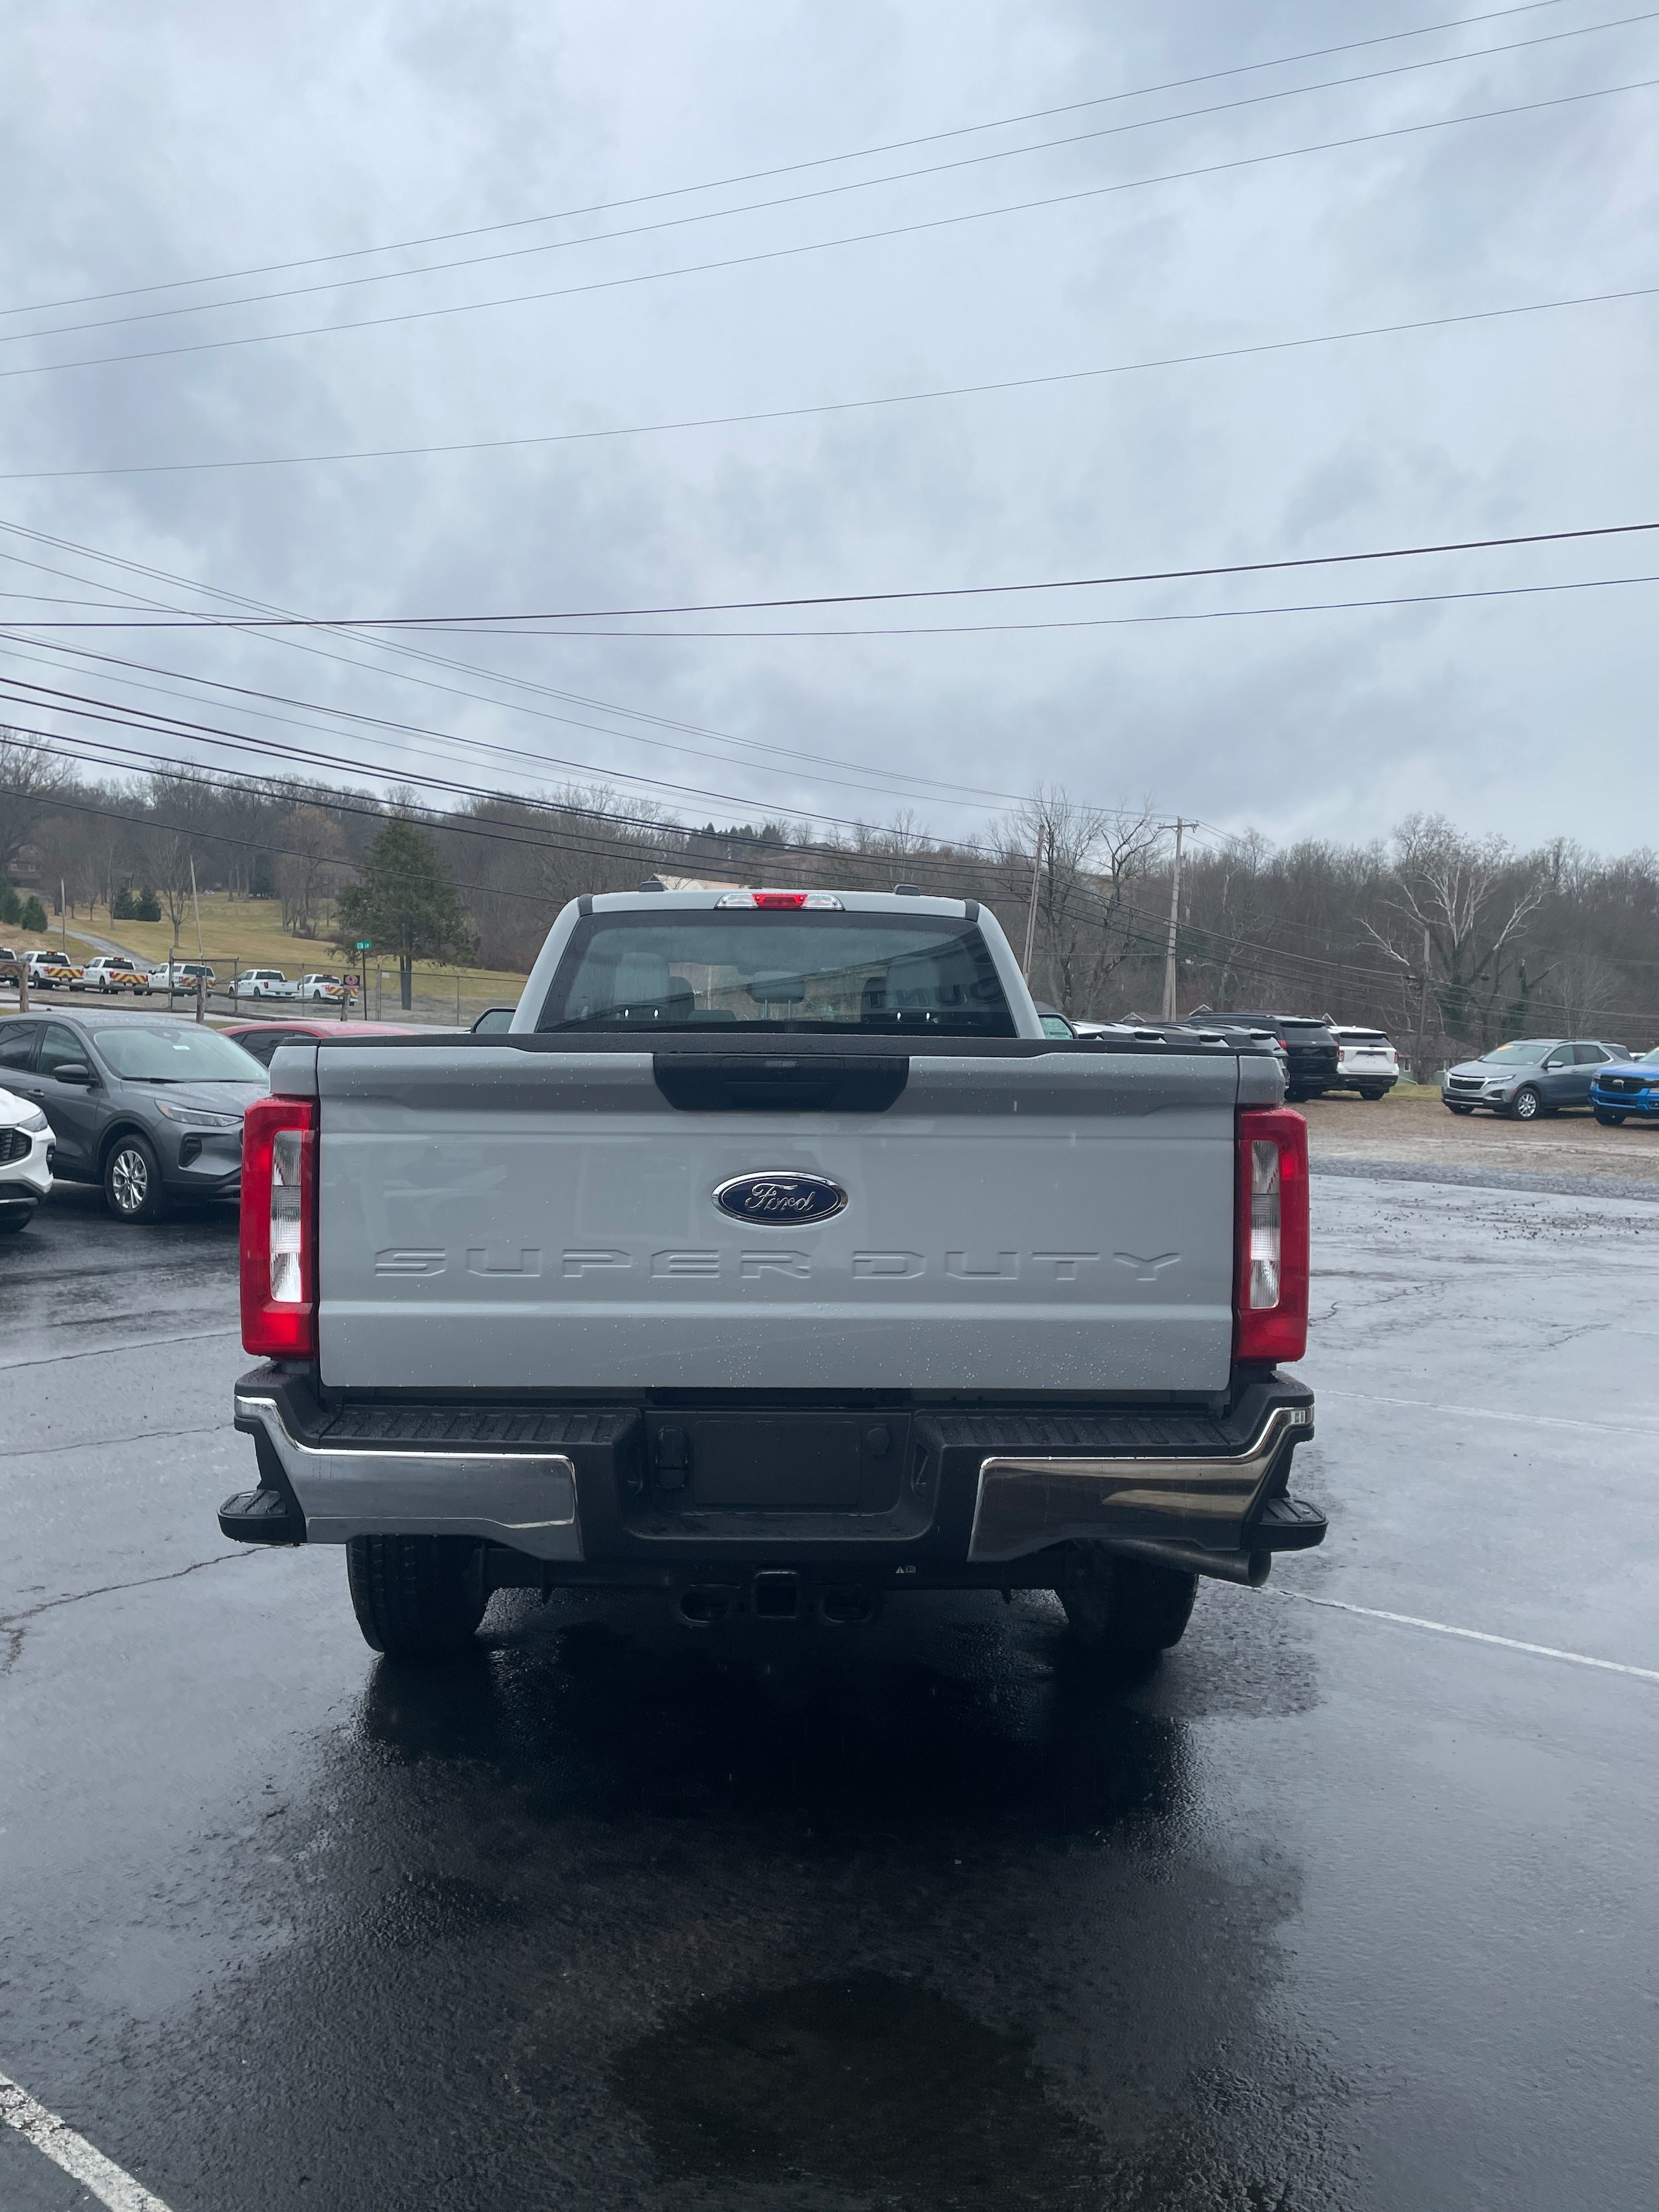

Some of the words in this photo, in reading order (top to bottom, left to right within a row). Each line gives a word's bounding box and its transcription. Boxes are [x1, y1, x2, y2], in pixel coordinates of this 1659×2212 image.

[744, 1183, 816, 1212] Ford
[375, 1248, 811, 1278] SUPER
[853, 1250, 1181, 1281] DUTY
